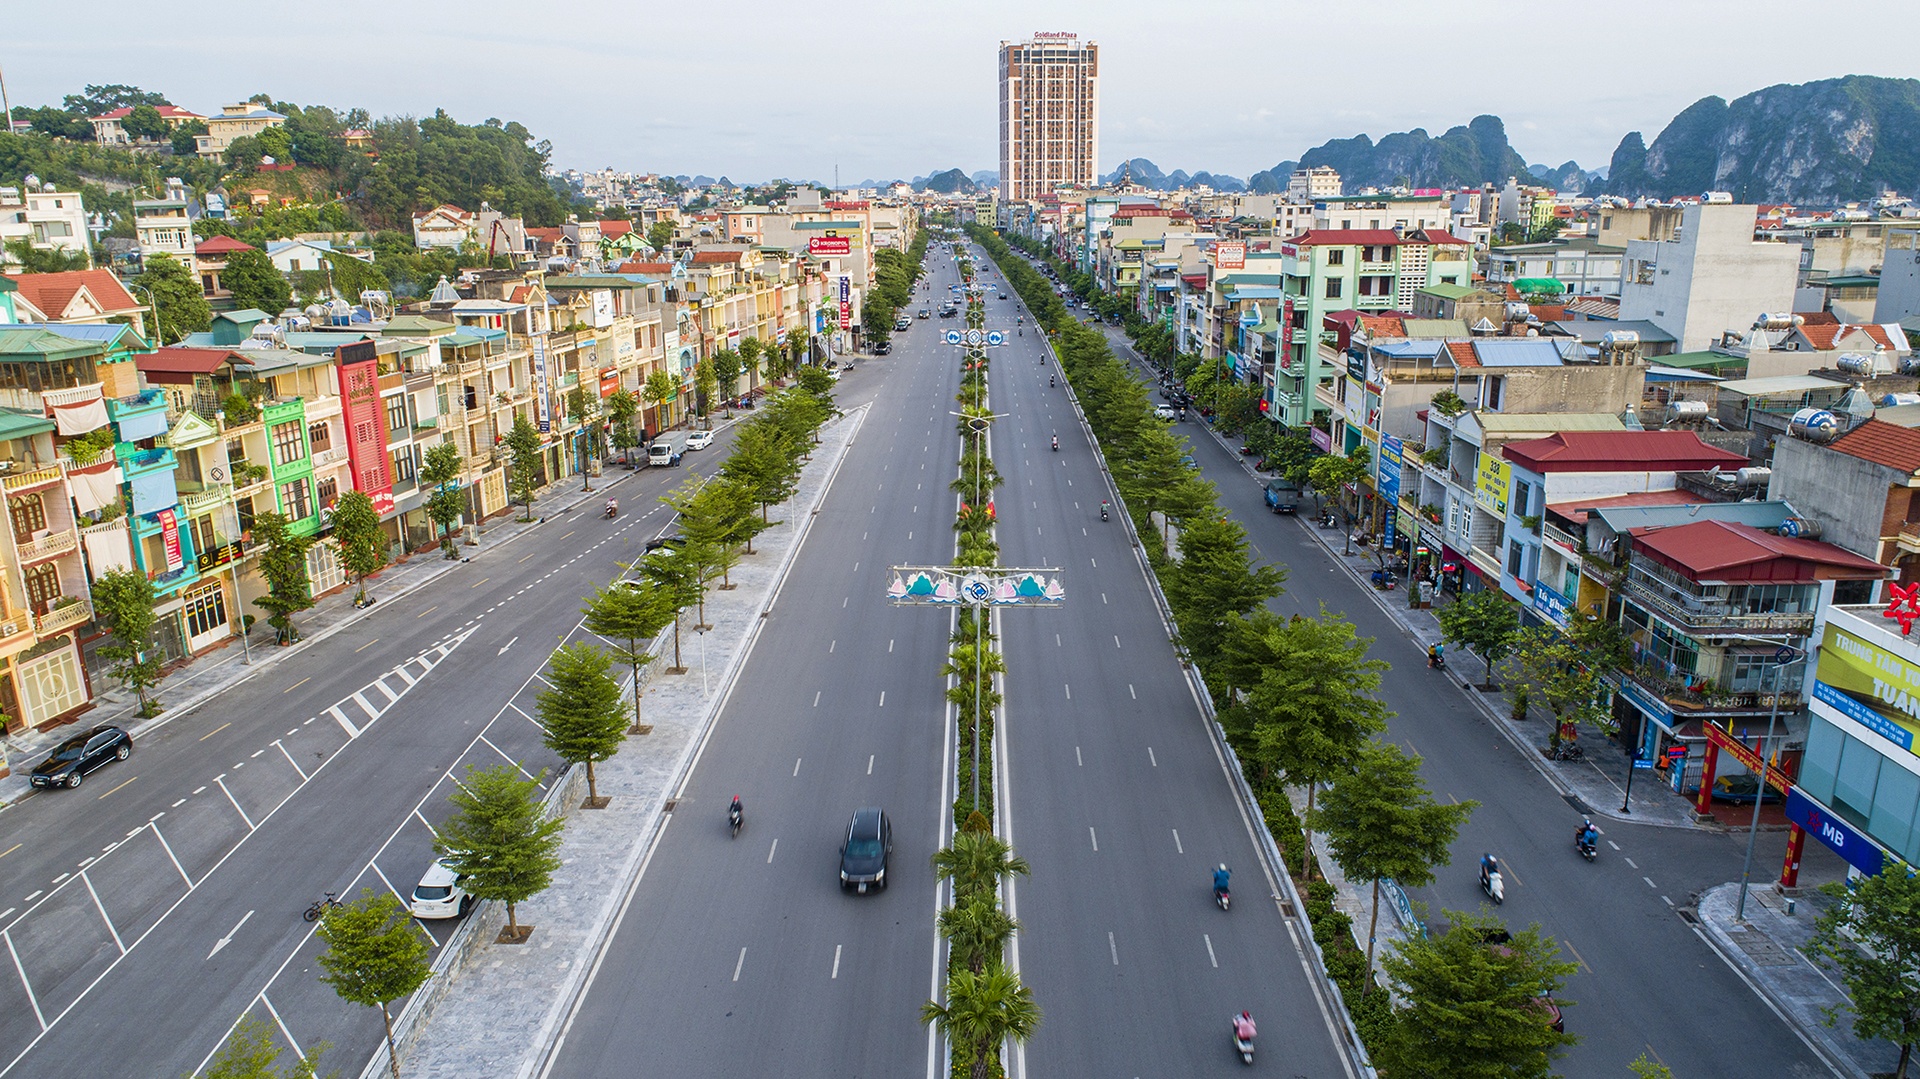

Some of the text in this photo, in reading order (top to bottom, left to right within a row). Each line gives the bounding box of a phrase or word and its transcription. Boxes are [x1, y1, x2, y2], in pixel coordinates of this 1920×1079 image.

[1490, 460, 1500, 474] 338
[1836, 633, 1873, 664] TRUNG
[1876, 653, 1902, 678] TÂM
[1725, 745, 1738, 758] KHU
[1740, 756, 1754, 768] PHỐ
[1822, 822, 1844, 847] MB
